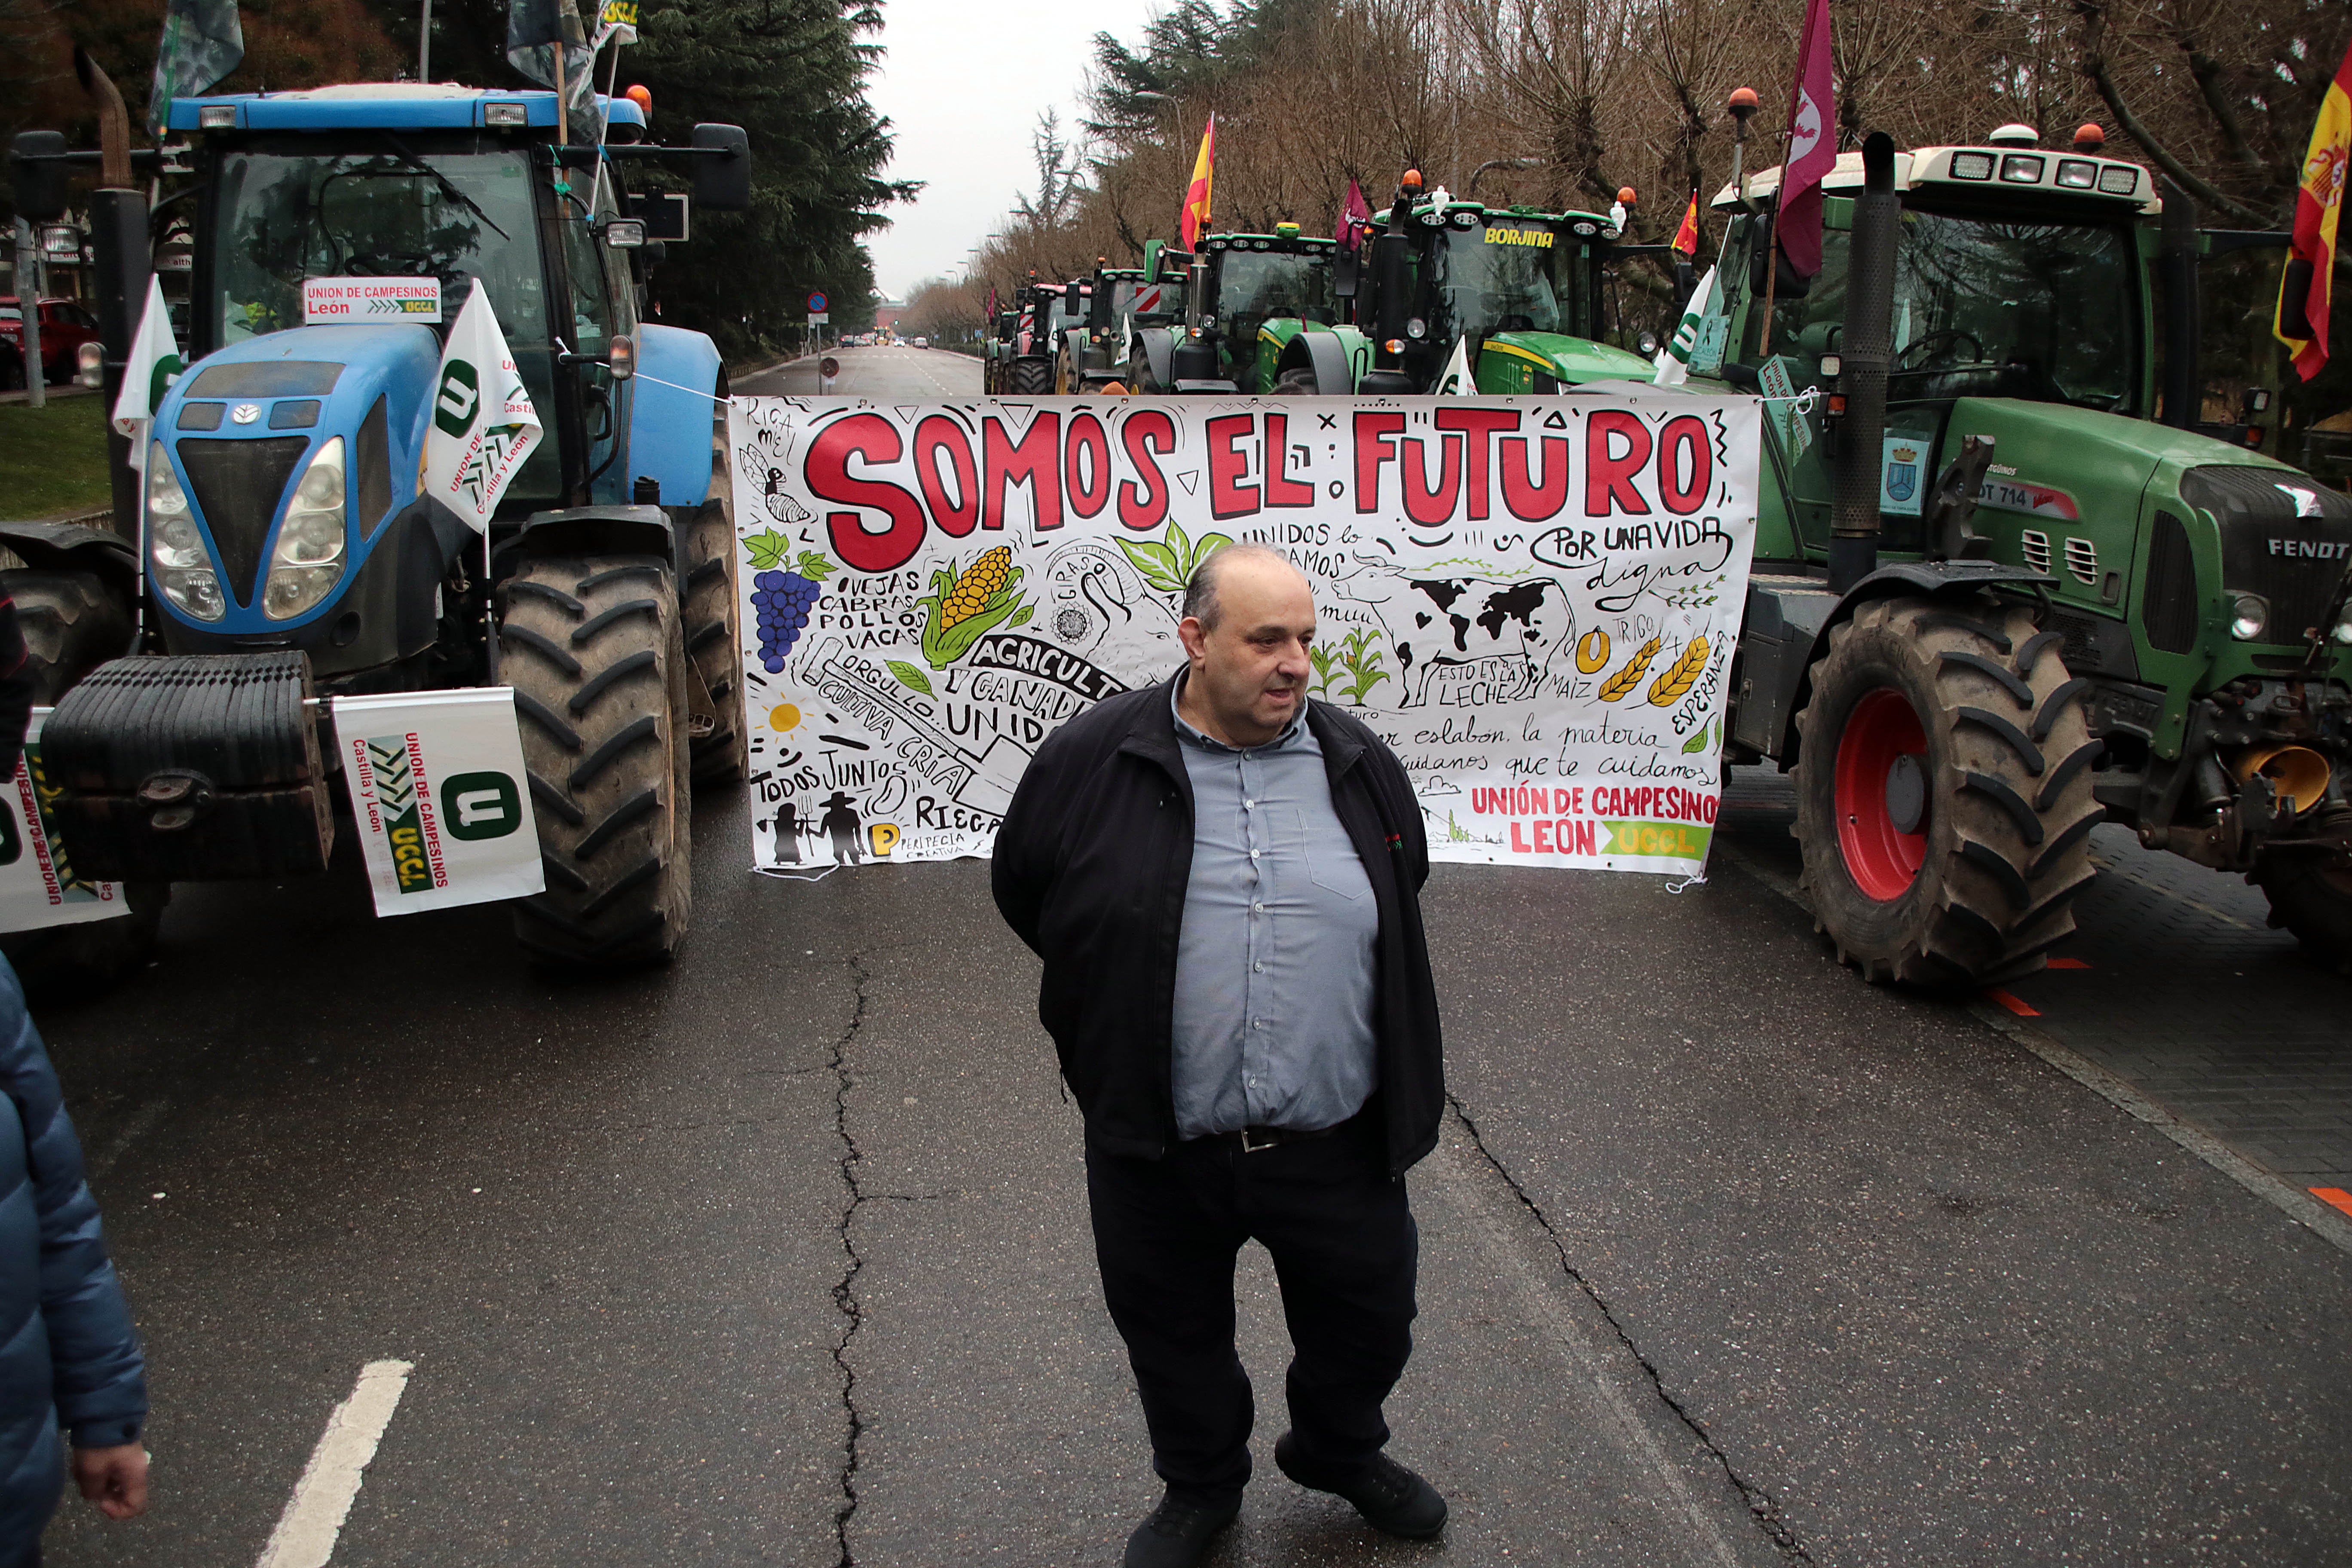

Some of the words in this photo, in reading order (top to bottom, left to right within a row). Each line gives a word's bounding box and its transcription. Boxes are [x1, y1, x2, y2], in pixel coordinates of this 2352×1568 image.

[1484, 228, 1554, 248] BORJINA
[308, 288, 343, 298] UNION
[347, 287, 361, 298] DE
[365, 286, 438, 298] CAMPESINOS
[308, 301, 349, 314] León
[1770, 359, 1783, 389] UNION
[450, 452, 473, 492] UNION
[470, 432, 482, 451] DE
[499, 463, 508, 473] y
[504, 435, 529, 463] León
[803, 409, 1176, 573] SOMOS
[1205, 413, 1315, 521] EL
[1353, 407, 1712, 528] FUTURO
[2000, 487, 2026, 506] 714
[1554, 527, 1598, 560] POR
[1604, 524, 1653, 551] UNA
[1654, 517, 1720, 549] VIDA
[2268, 539, 2350, 559] FENDT
[838, 572, 919, 596] OVEJAS
[1586, 556, 1707, 612] digna
[819, 595, 914, 612] CABRAS
[820, 612, 926, 629] POLLOS
[1612, 614, 1654, 644] TRIGO
[845, 628, 919, 650] VACAS
[945, 668, 970, 694] Y
[973, 638, 1123, 700] AGRICULT
[1439, 665, 1475, 680] ESTO
[1480, 661, 1497, 682] ES
[1499, 669, 1516, 683] LA
[1672, 631, 1730, 735] ESPERANZA
[1439, 682, 1508, 708] LECHE
[946, 703, 1044, 744] UNID
[1522, 712, 1543, 742] la
[1558, 710, 1670, 748] materia
[352, 738, 373, 788] Castilla
[405, 732, 426, 779] UNION
[1505, 755, 1550, 780] que
[1556, 746, 1579, 776] te
[1598, 752, 1718, 786] cuidamos
[413, 780, 430, 800] DE
[750, 766, 821, 803] TODOS
[818, 749, 907, 790] JUNTOS
[361, 790, 374, 799] y
[1471, 780, 1549, 816] UNIÓN
[1553, 787, 1584, 815] DE
[365, 802, 382, 833] León
[420, 801, 449, 888] CAMPESINOS
[901, 833, 965, 851] PERIPECIA
[1510, 812, 1597, 857] LEÓN
[1618, 827, 1696, 854] UCCL
[34, 839, 51, 862] DE
[390, 827, 427, 887] UCCL
[40, 862, 62, 905] UNION
